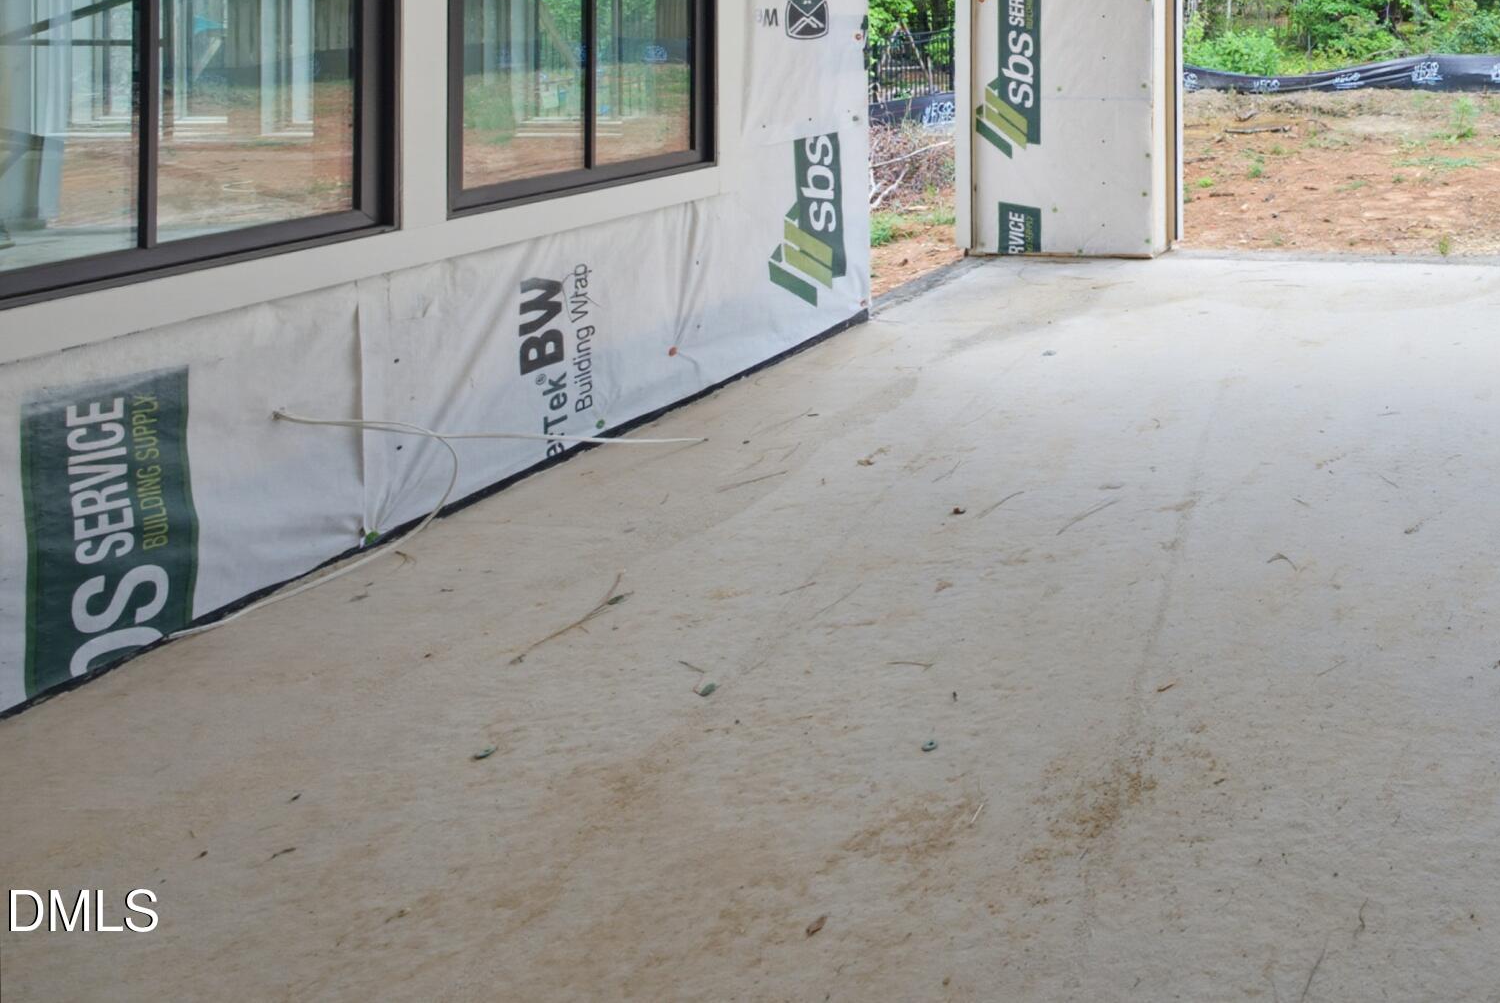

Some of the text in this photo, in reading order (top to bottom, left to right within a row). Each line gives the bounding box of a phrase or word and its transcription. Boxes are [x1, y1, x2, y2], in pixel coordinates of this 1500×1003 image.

[1001, 30, 1035, 109] sbs
[518, 277, 565, 377] BW
[570, 262, 596, 414] Building Wrap
[66, 397, 135, 565] SERVICE
[132, 391, 169, 551] BUILDING SUPPLY
